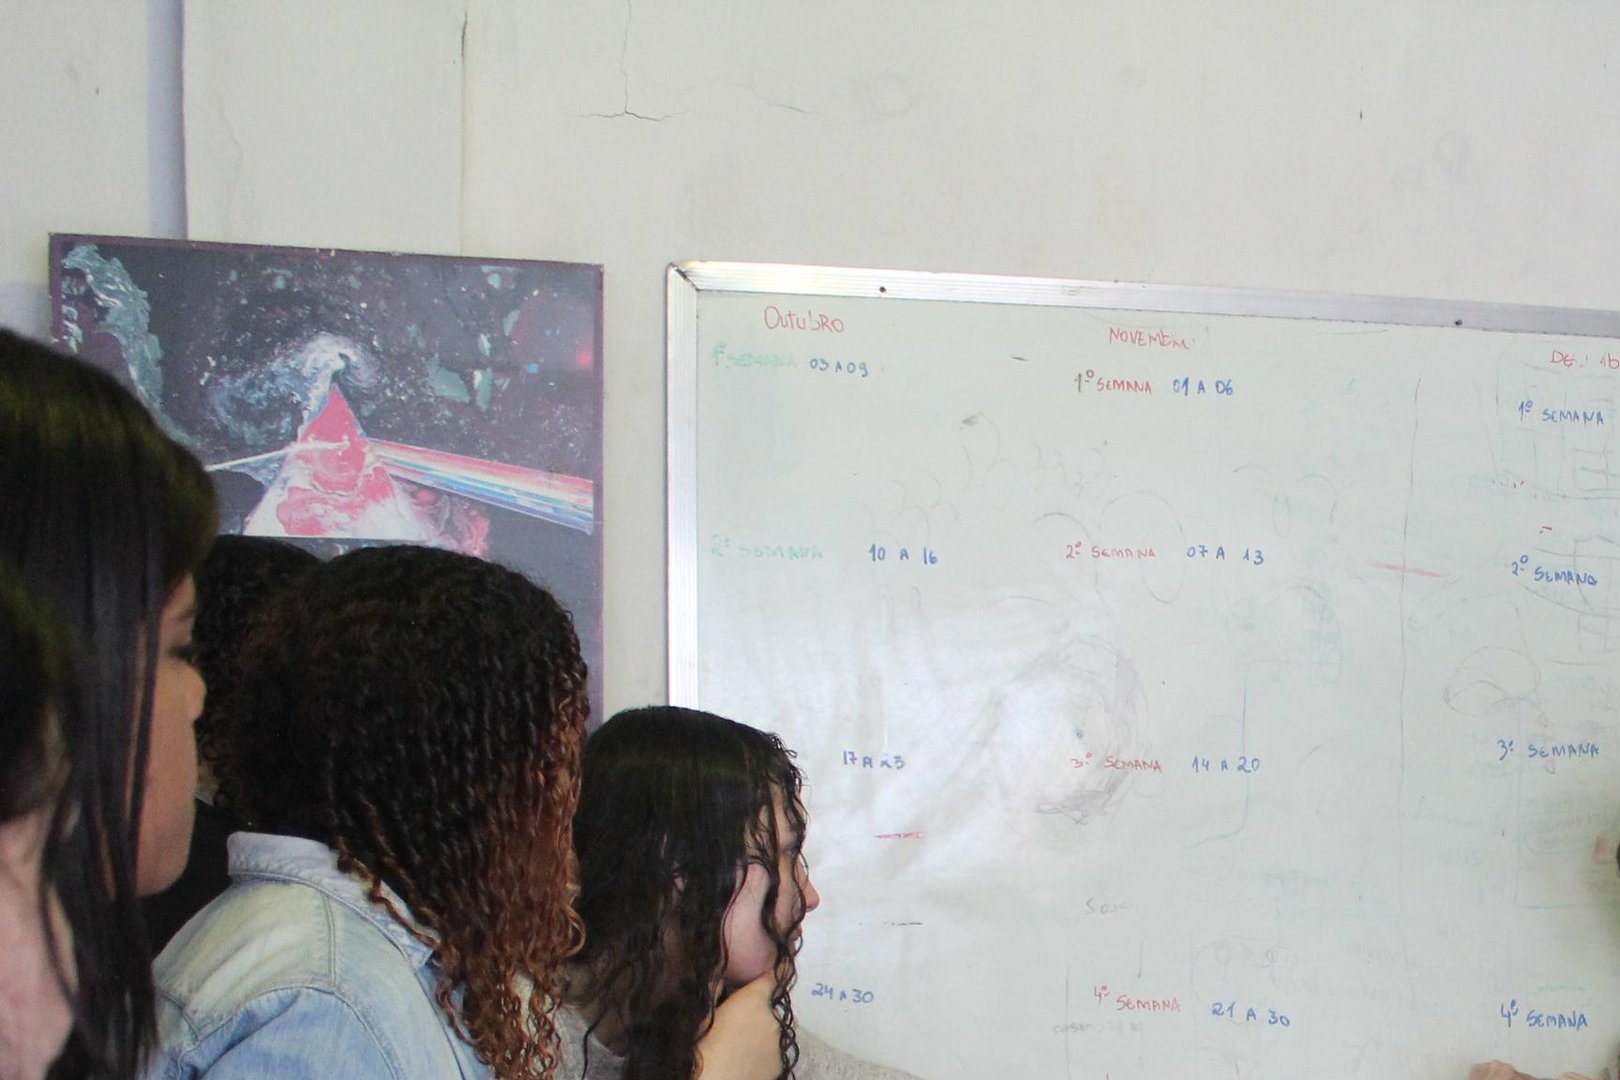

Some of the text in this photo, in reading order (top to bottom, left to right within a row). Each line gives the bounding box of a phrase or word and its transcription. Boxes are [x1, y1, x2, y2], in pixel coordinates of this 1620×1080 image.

[810, 358, 829, 371] 03
[835, 362, 842, 373] A
[847, 362, 868, 377] 09
[1097, 377, 1152, 393] SEMANA
[1173, 377, 1189, 396] 01
[1197, 379, 1206, 394] A
[1215, 379, 1234, 396] 06
[1542, 410, 1604, 425] SEMANA
[868, 544, 886, 561] 10
[900, 548, 909, 560] A
[923, 547, 938, 564] 16
[1091, 546, 1156, 559] SEMANA
[1187, 545, 1208, 558] 07
[1216, 547, 1226, 560] A
[1243, 547, 1264, 565] 13
[843, 751, 858, 766] 17
[863, 756, 873, 768] A
[1528, 744, 1600, 759] SEMANA
[1103, 755, 1162, 772] SEMANA
[1192, 755, 1209, 772] 14
[1221, 759, 1228, 770] A
[1237, 756, 1260, 773] 20
[811, 982, 833, 999] 24
[852, 988, 874, 1003] 30
[1116, 995, 1181, 1012] SEMANA
[1212, 1001, 1236, 1017] 21
[1246, 1008, 1256, 1020] A
[1268, 1010, 1290, 1027] 30
[1527, 1010, 1588, 1031] SEMANA
